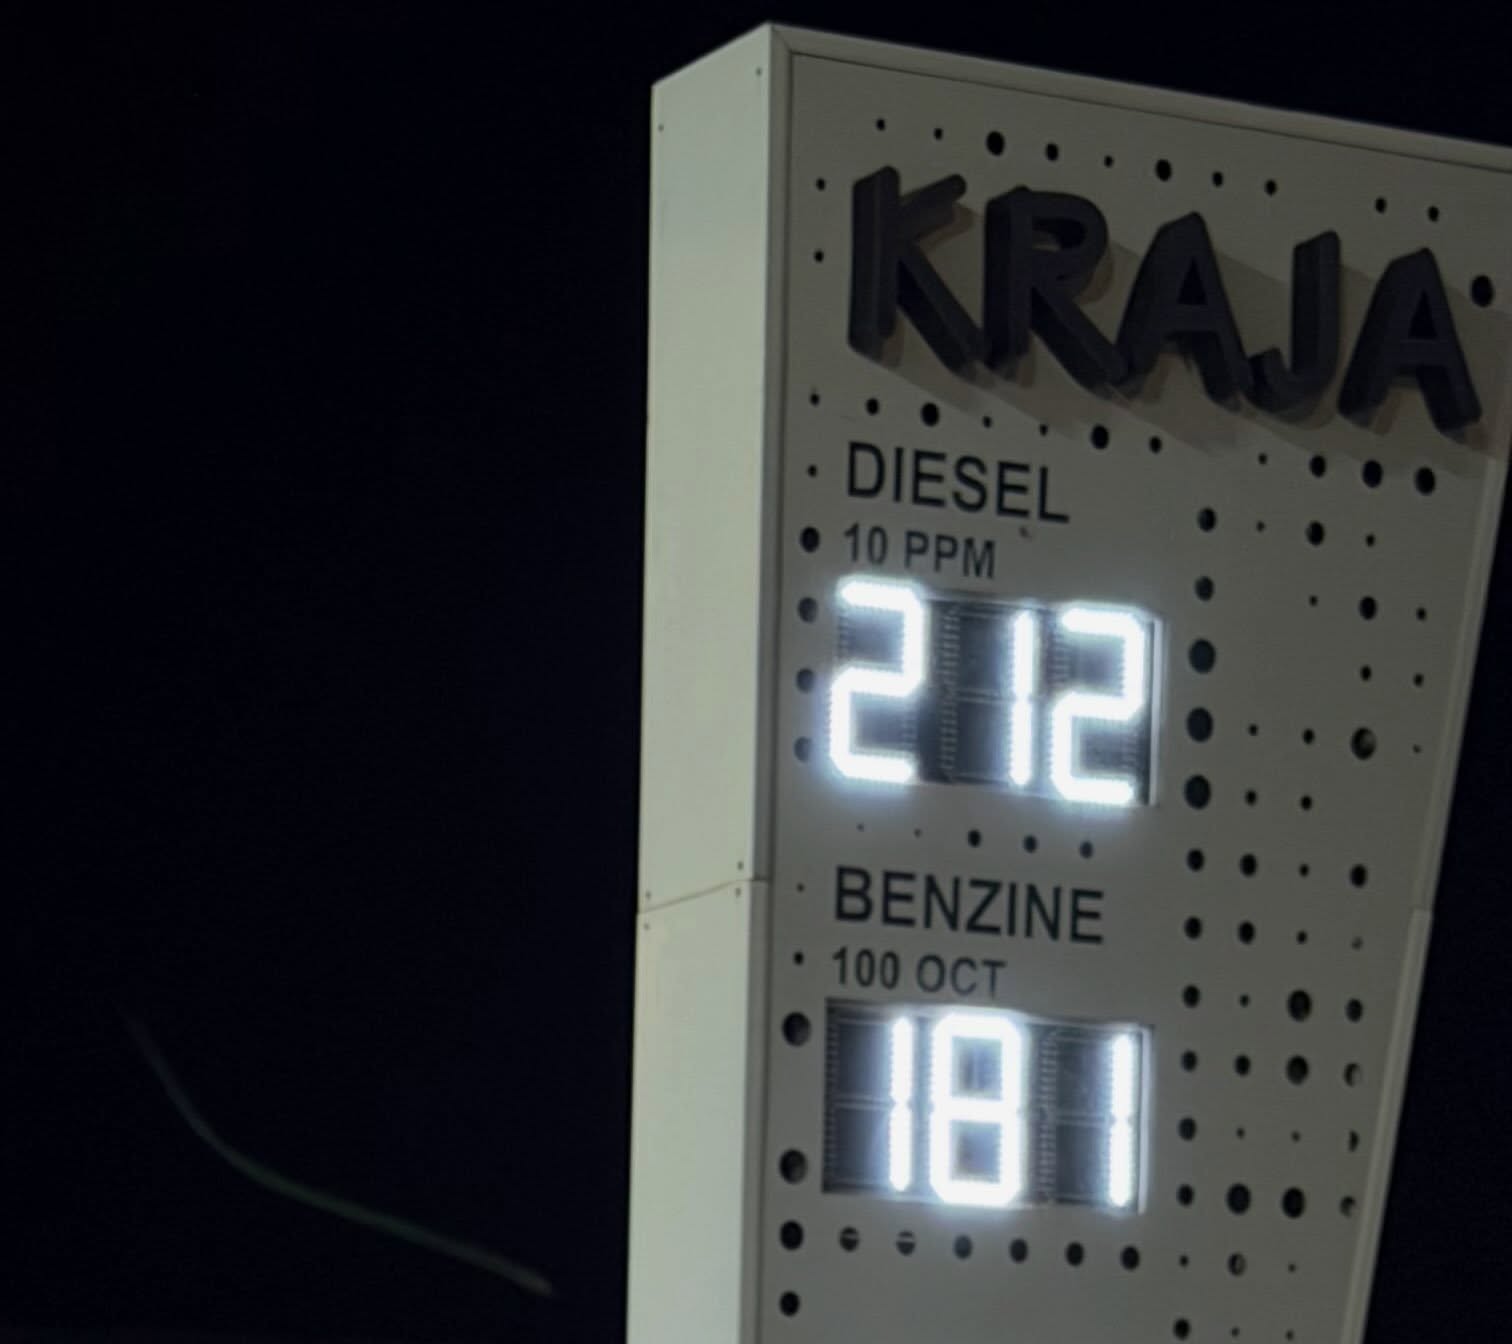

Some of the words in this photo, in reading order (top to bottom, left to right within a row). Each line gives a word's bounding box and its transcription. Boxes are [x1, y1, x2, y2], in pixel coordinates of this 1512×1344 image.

[847, 165, 1482, 438] KRAJA
[845, 440, 1072, 525] DIESEL
[843, 523, 888, 566] 10
[903, 527, 997, 580] PPM
[826, 574, 1148, 807] 212
[833, 865, 1105, 945] BENZINE
[832, 946, 900, 991] 100
[916, 953, 1007, 998] OCT
[886, 1007, 1135, 1208] 181
